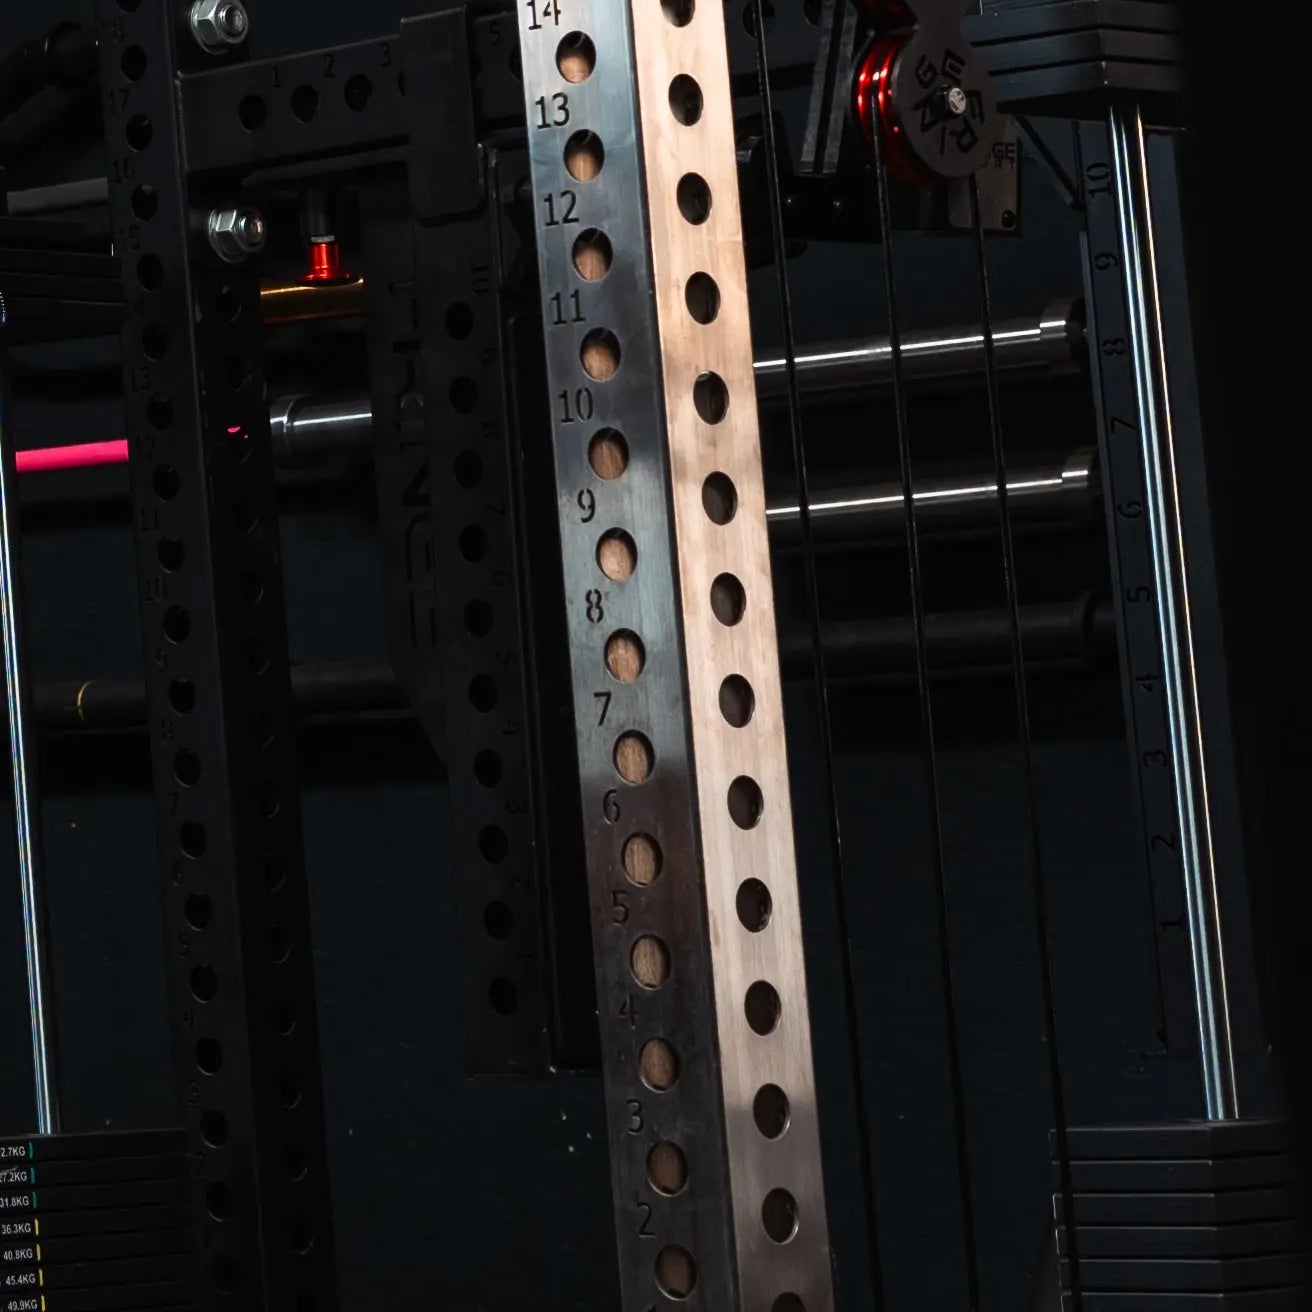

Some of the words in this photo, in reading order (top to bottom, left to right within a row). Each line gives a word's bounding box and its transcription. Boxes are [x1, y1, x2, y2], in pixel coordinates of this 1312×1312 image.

[534, 92, 571, 129] 13
[1086, 162, 1111, 198] 10
[543, 189, 579, 226] 12
[551, 289, 585, 325] 11
[1102, 338, 1126, 356] 8
[558, 386, 594, 424] 10
[1111, 416, 1137, 434] 7
[577, 488, 596, 523] 9
[585, 588, 604, 623] 8
[593, 691, 612, 726] 7
[1143, 749, 1168, 768] 3
[602, 788, 621, 825] 6
[612, 890, 630, 926] 5
[619, 993, 639, 1029] 4
[627, 1098, 645, 1135] 3
[0, 1196, 30, 1209] 31.8KG
[637, 1201, 655, 1237] 2
[1, 1222, 31, 1235] 36.3KG
[5, 1274, 36, 1286] 45.4KG
